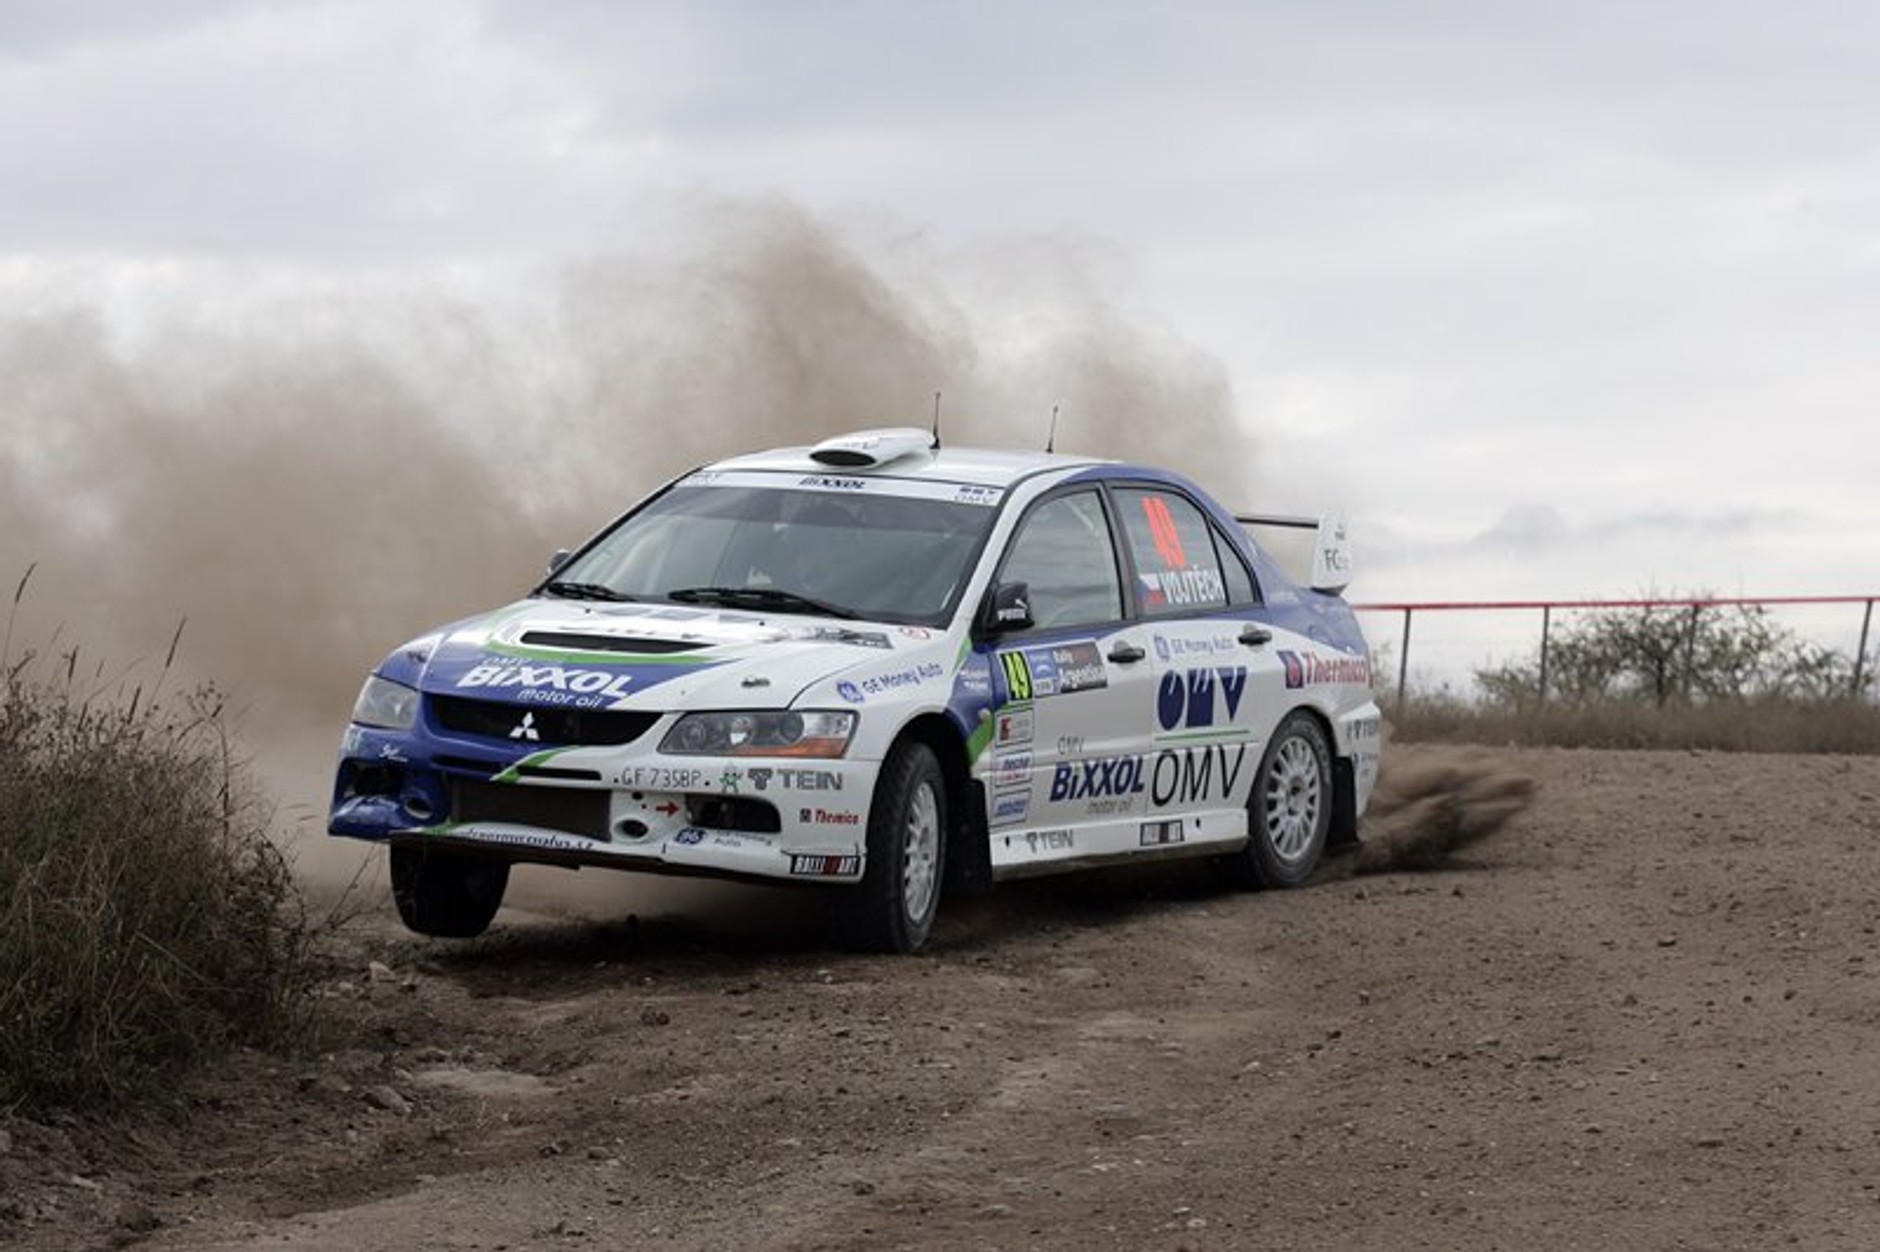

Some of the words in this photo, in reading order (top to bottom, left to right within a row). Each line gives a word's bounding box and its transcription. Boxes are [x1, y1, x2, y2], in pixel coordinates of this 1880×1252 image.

[880, 672, 920, 689] Money
[917, 663, 943, 678] Auto
[517, 689, 574, 704] motor
[576, 696, 603, 708] oil
[778, 769, 843, 790] TEIN
[1151, 742, 1245, 807] OMV
[1038, 830, 1074, 850] TEIN
